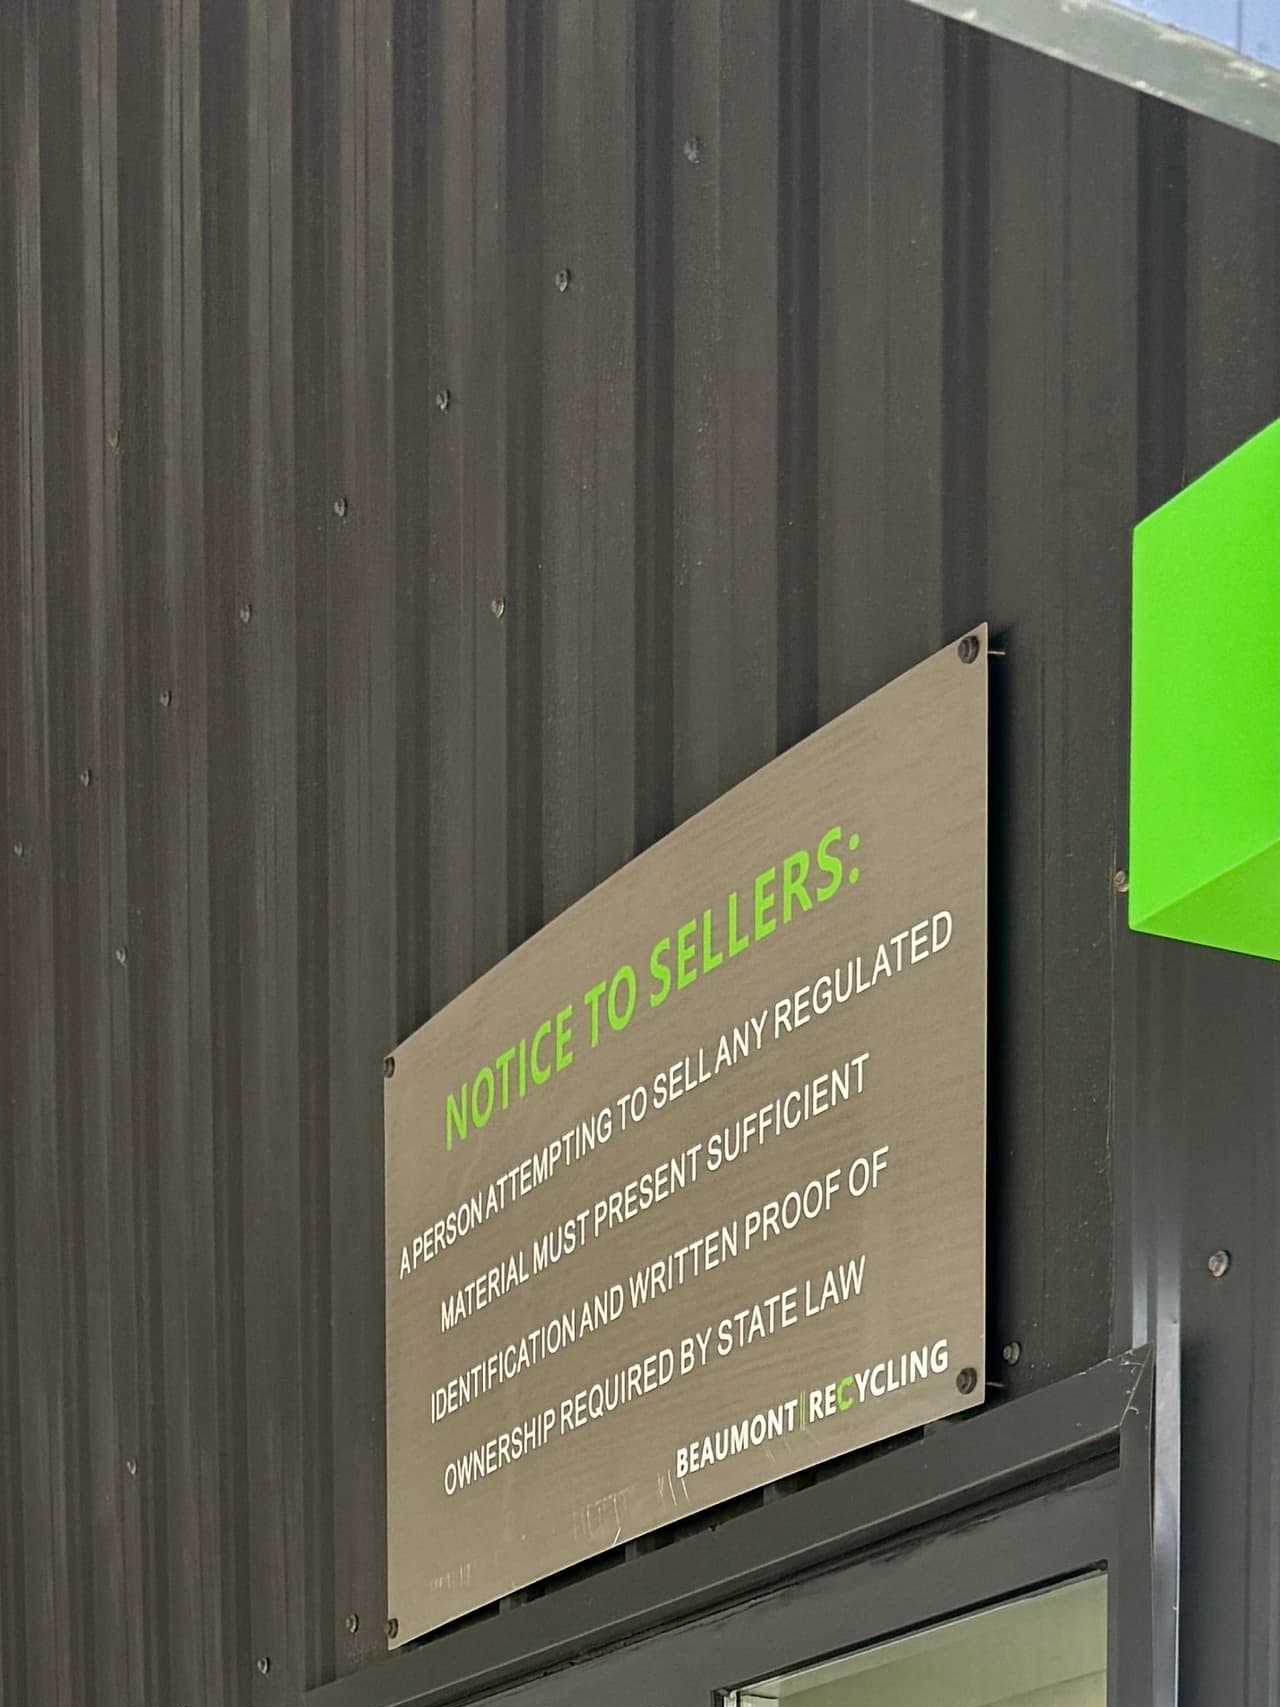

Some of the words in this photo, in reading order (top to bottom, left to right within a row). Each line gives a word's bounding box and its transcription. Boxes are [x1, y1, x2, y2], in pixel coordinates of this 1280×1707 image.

[400, 1248, 411, 1279] A
[412, 1193, 482, 1268] PERSON
[486, 1108, 612, 1218] ATTEMPTING
[617, 1087, 648, 1129] TO
[653, 1049, 712, 1108] SELL
[715, 1011, 768, 1073] ANY
[774, 912, 953, 1038] REGULATED
[446, 1005, 572, 1150] NOTICE
[584, 966, 637, 1047] TO
[649, 827, 861, 1006] SELLERS:
[431, 1310, 575, 1423] IDENTIFICATION
[580, 1285, 624, 1337] AND
[629, 1222, 739, 1307] WRITTEN
[745, 1169, 840, 1249] PROOF
[848, 1146, 889, 1196] OF
[441, 1252, 529, 1332] MATERIAL
[534, 1210, 590, 1273] MUST
[594, 1144, 702, 1236] PRESENT
[707, 1053, 869, 1170] SUFFICIENT
[445, 1409, 555, 1494] OWNERSHIP
[560, 1349, 674, 1434] REQUIRED
[680, 1328, 712, 1374] BY
[717, 1288, 797, 1355] STATE
[805, 1256, 866, 1316] LAW
[676, 1400, 798, 1477] BEAUMONT
[809, 1339, 948, 1422] RECYCLING
